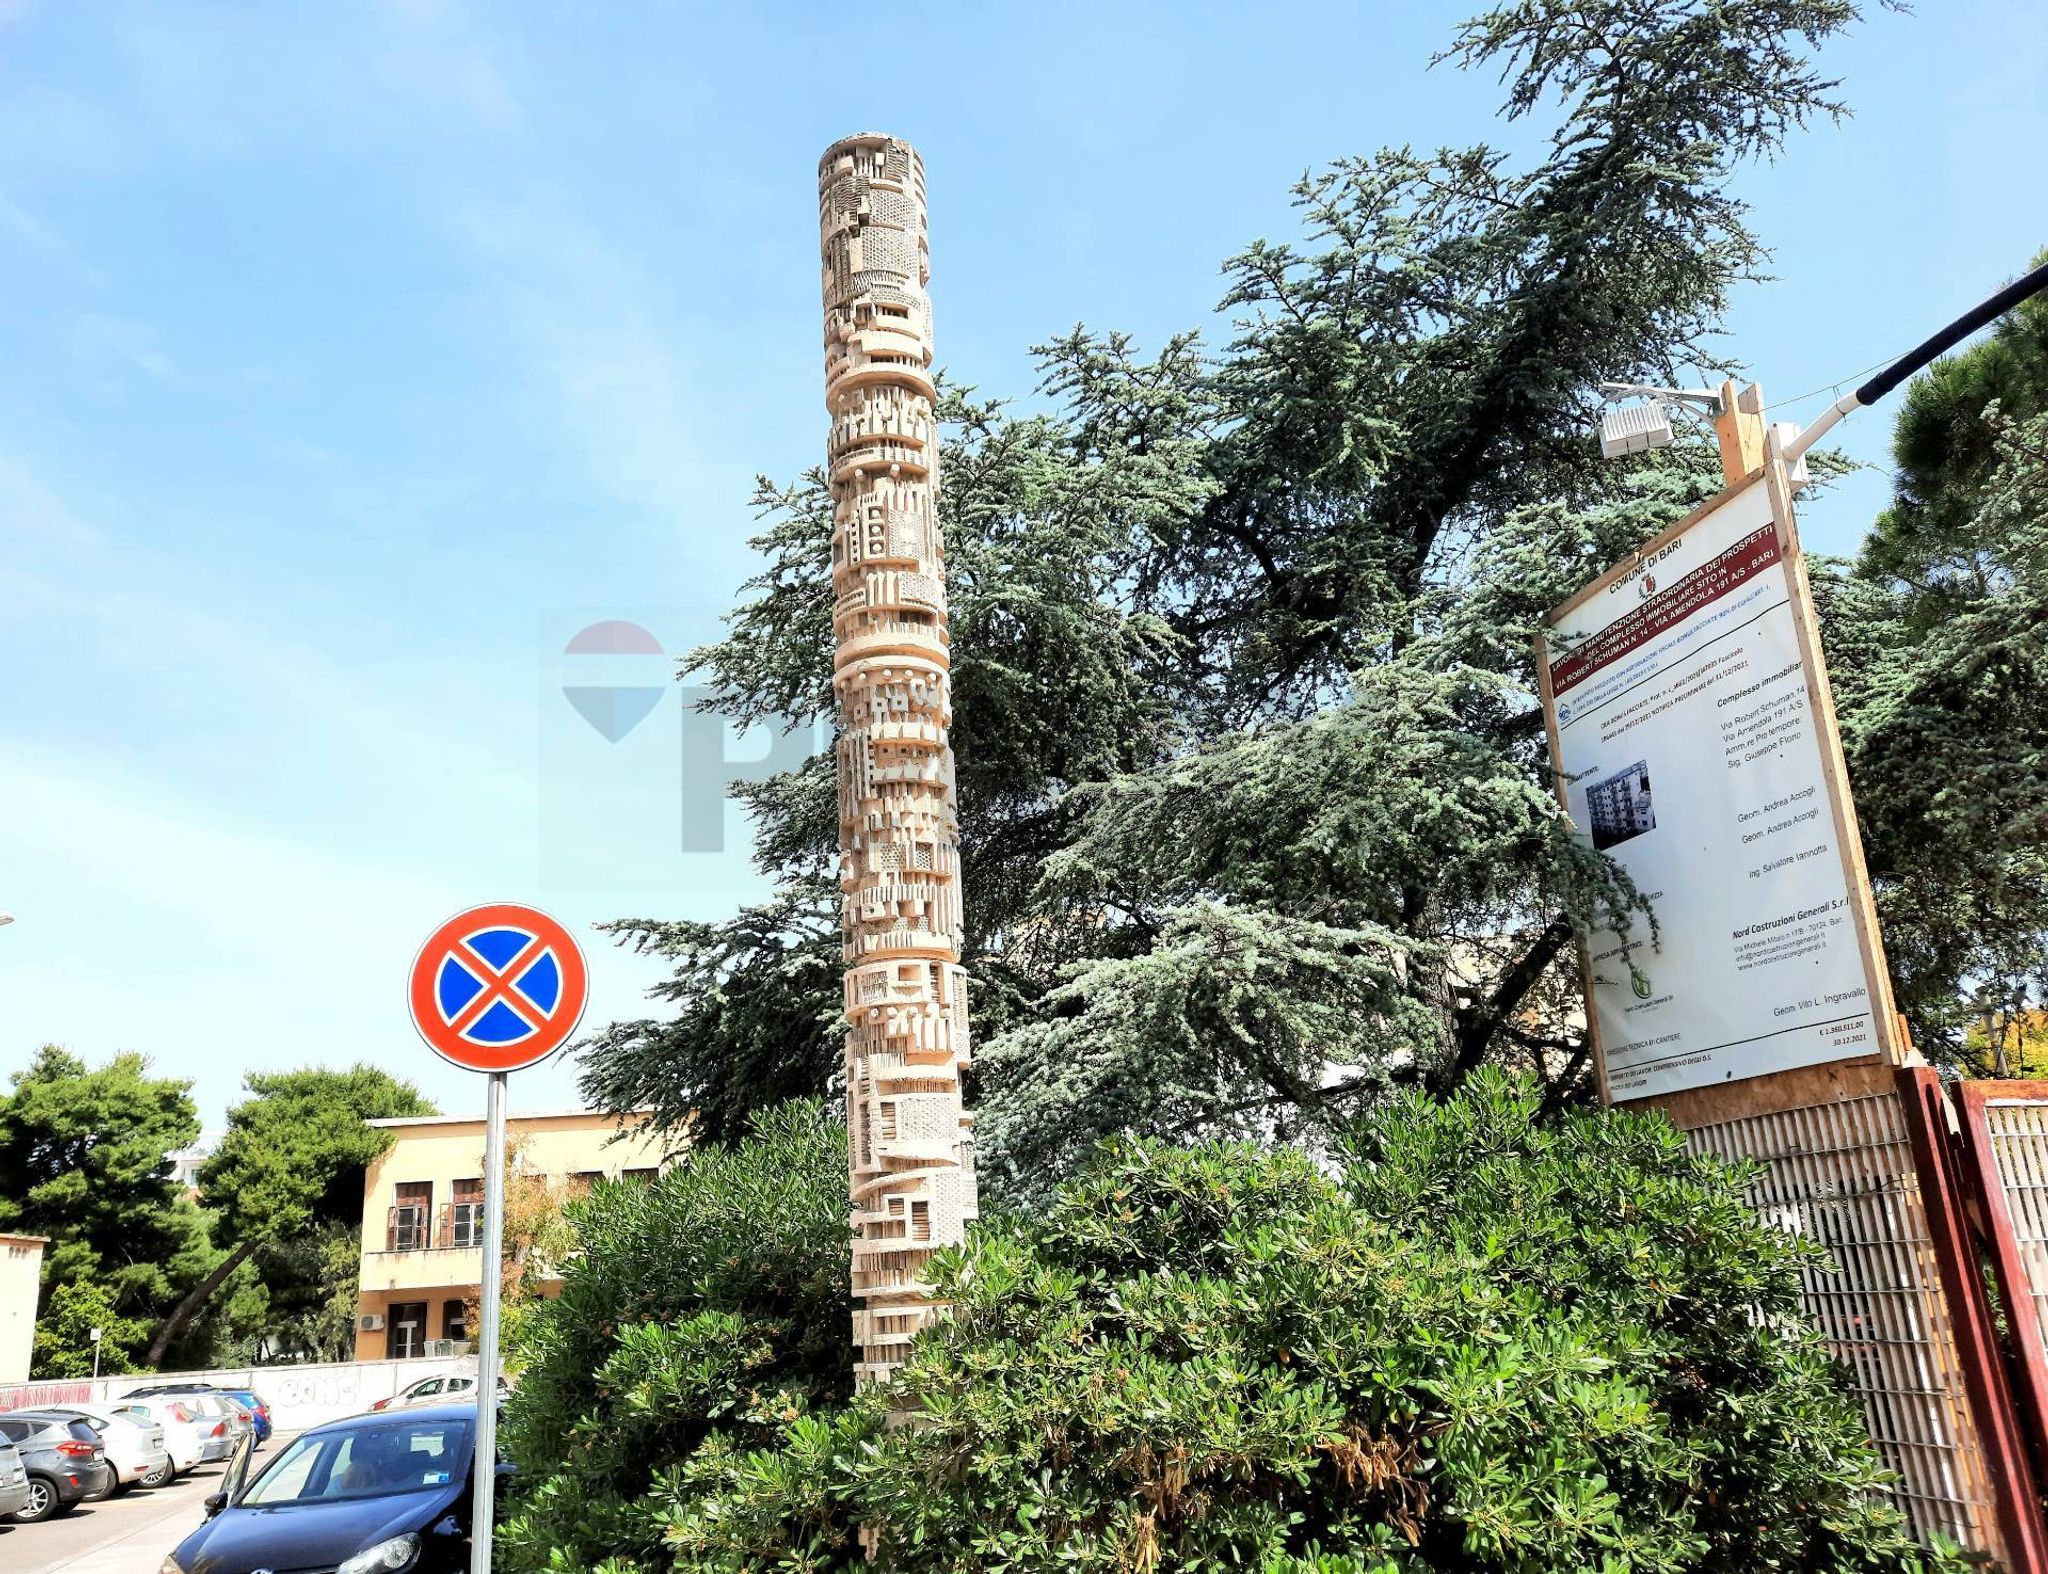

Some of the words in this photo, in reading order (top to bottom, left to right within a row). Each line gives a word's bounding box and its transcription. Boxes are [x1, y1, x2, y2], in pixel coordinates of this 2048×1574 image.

[1609, 561, 1646, 594] COMUNE
[1647, 554, 1657, 568] DI
[1659, 537, 1682, 560] BARI
[1552, 651, 1573, 671] LAVOR
[1585, 607, 1641, 650] MANUTENZIONE
[1641, 567, 1704, 614] STRAORDINARIA
[1705, 556, 1721, 573] DEI
[1721, 522, 1773, 563] PROSPETTI
[1599, 616, 1645, 651] COMPLESSO
[1645, 585, 1694, 622] IMMOBILIARE
[1696, 571, 1717, 591] SITO
[1718, 565, 1726, 577] IN
[1555, 677, 1566, 691] VIA
[1566, 660, 1593, 683] ROBERT
[1593, 636, 1630, 666] SCHUMAN
[1639, 626, 1648, 638] 14
[1654, 613, 1667, 628] VIA
[1669, 584, 1714, 619] AMENDOLA
[1716, 576, 1728, 591] 191
[1730, 566, 1745, 582] A/S
[1751, 548, 1774, 569] BARI
[1717, 679, 1760, 709] Complesso
[1760, 659, 1802, 687] immobiliar
[1720, 719, 1732, 732] Via
[1734, 706, 1759, 725] Robert
[1722, 730, 1735, 744] Via
[1736, 713, 1772, 738] Amendola
[1773, 706, 1786, 719] 191
[1744, 740, 1778, 763] Giuseppe
[1755, 729, 1767, 742] Pro
[1763, 795, 1788, 813] Andrea
[1766, 817, 1792, 835] Andrea
[1762, 854, 1794, 873] Salvatore
[1731, 926, 1750, 940] Nord
[1750, 911, 1796, 934] Costruzioni
[1796, 901, 1830, 920] Generali
[1823, 985, 1866, 1005] Ingravallo
